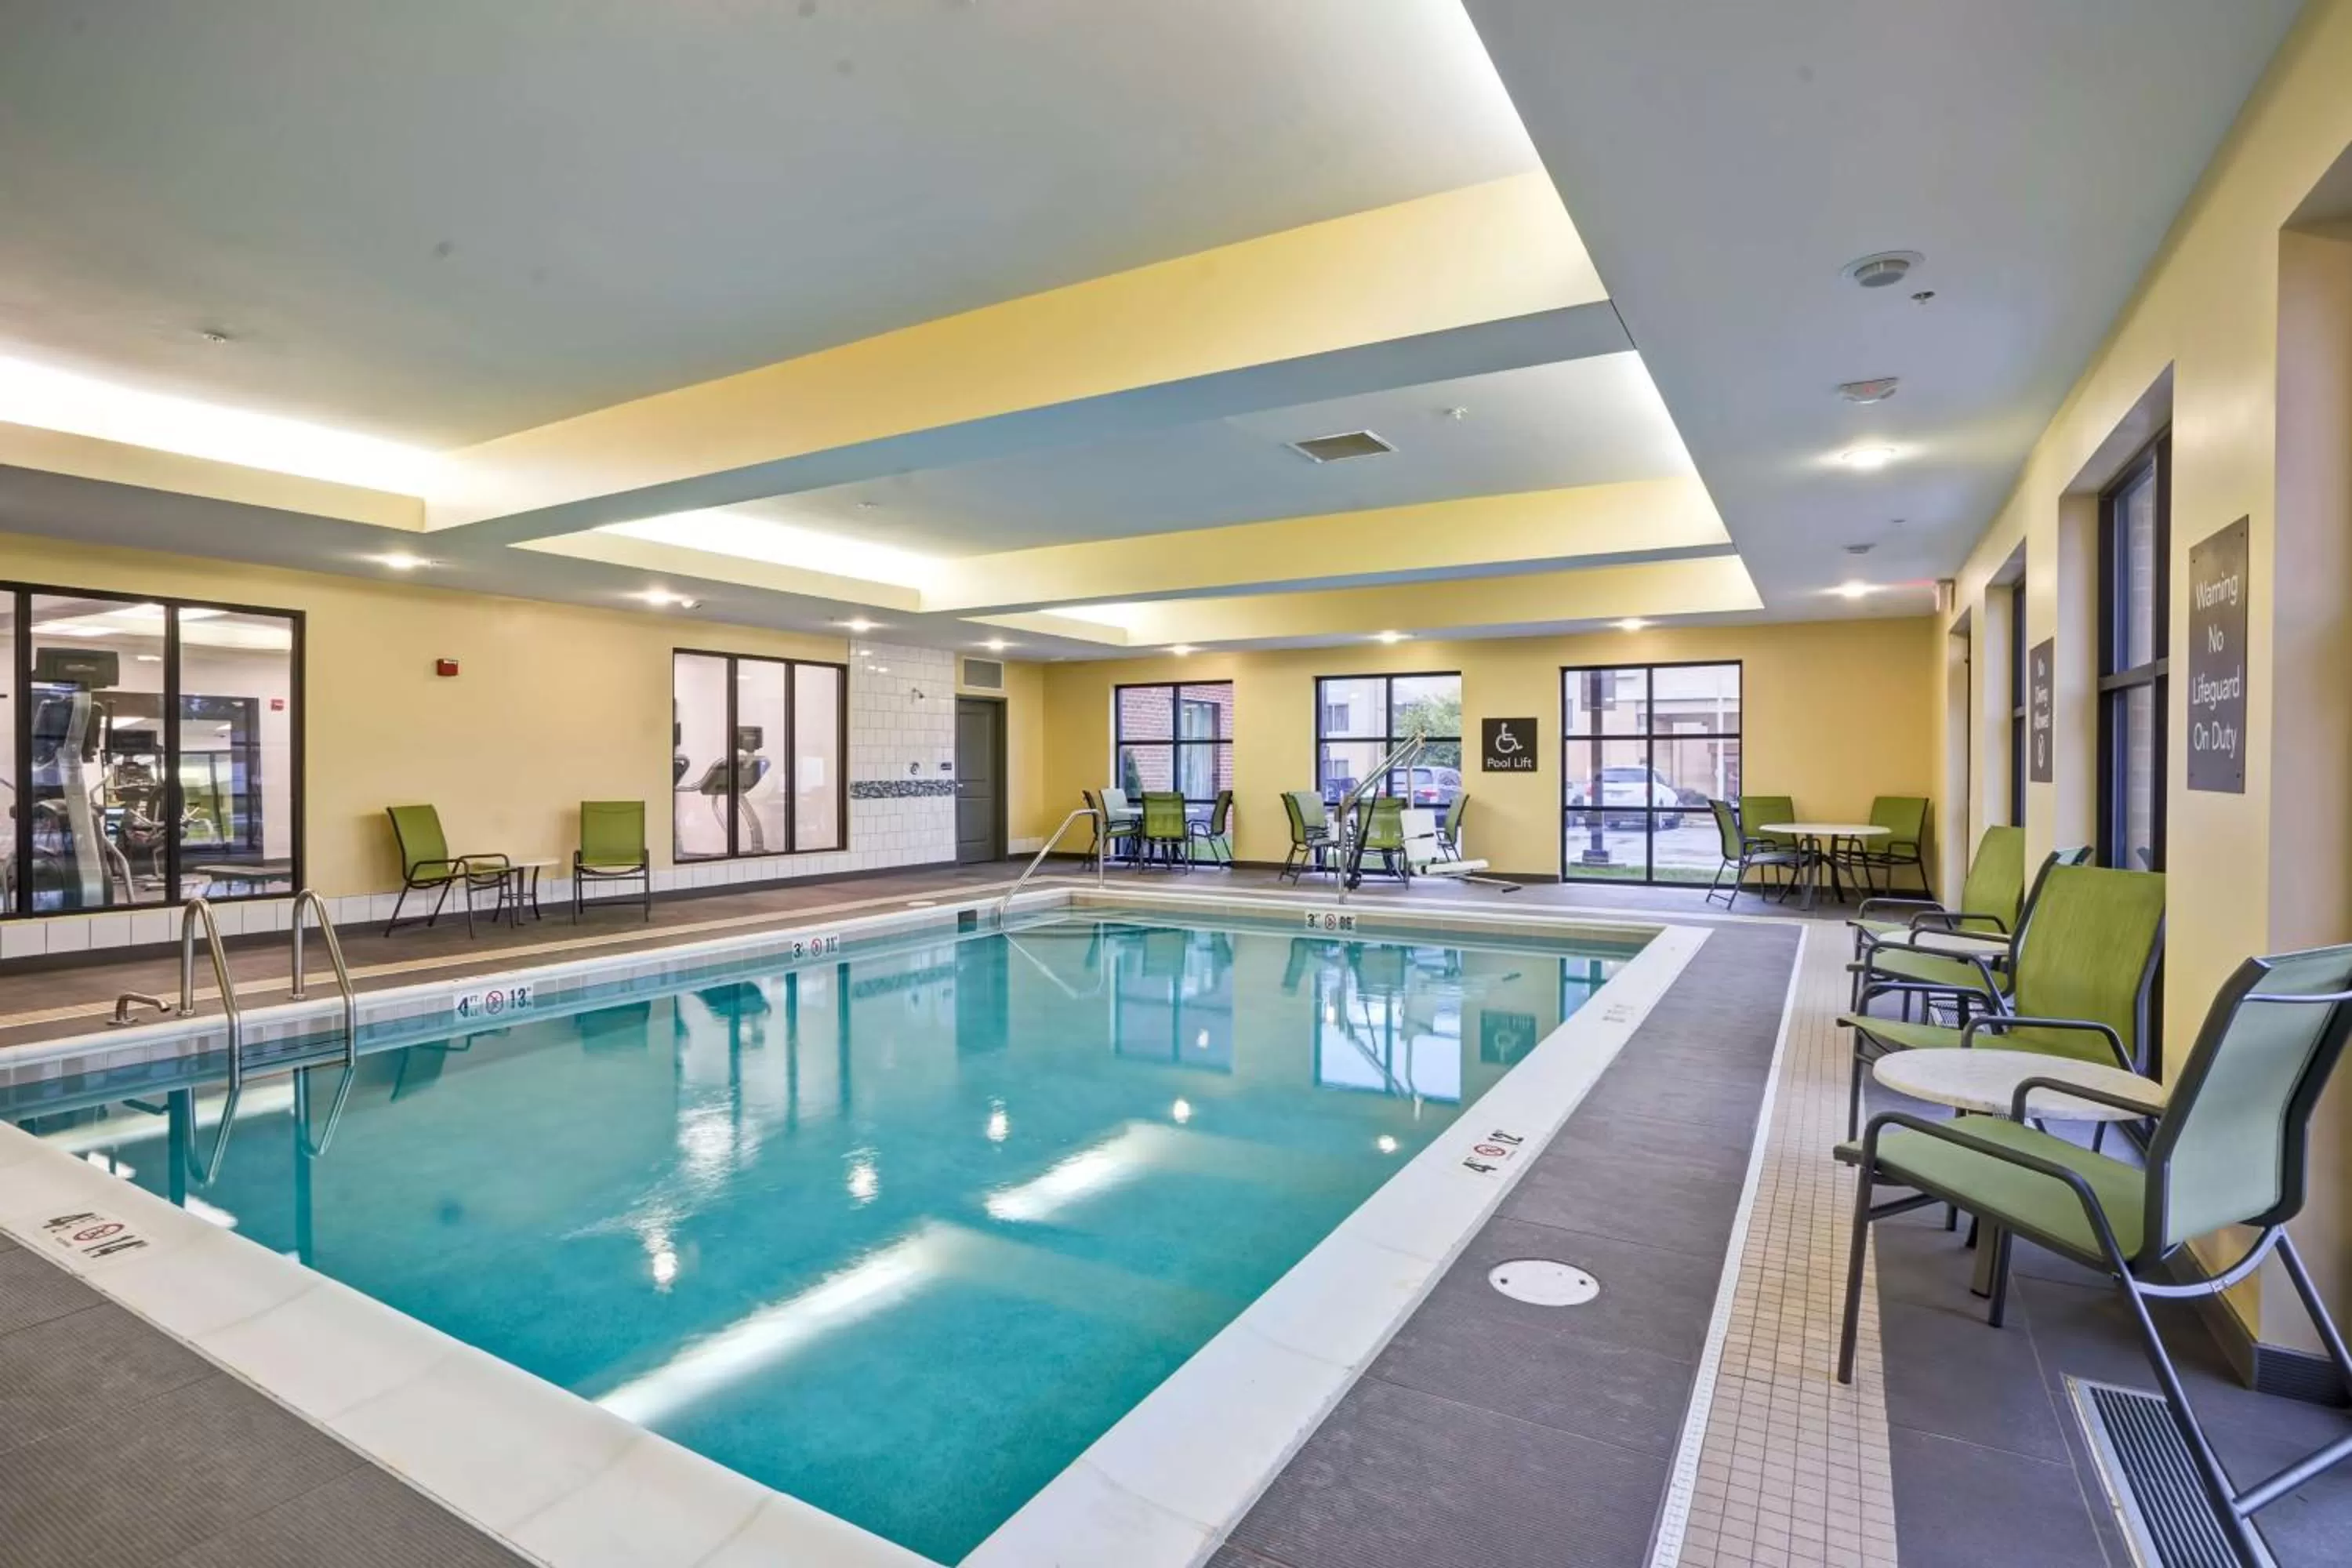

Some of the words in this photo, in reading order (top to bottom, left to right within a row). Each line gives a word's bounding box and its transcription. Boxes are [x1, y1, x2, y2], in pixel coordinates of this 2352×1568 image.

[2196, 572, 2238, 610] Warning
[2209, 625, 2223, 652] No
[2192, 665, 2240, 710] Lifeguard
[2194, 723, 2209, 750] On
[2212, 721, 2236, 758] Duty
[1487, 757, 1510, 768] Pool
[1515, 757, 1532, 768] Lift
